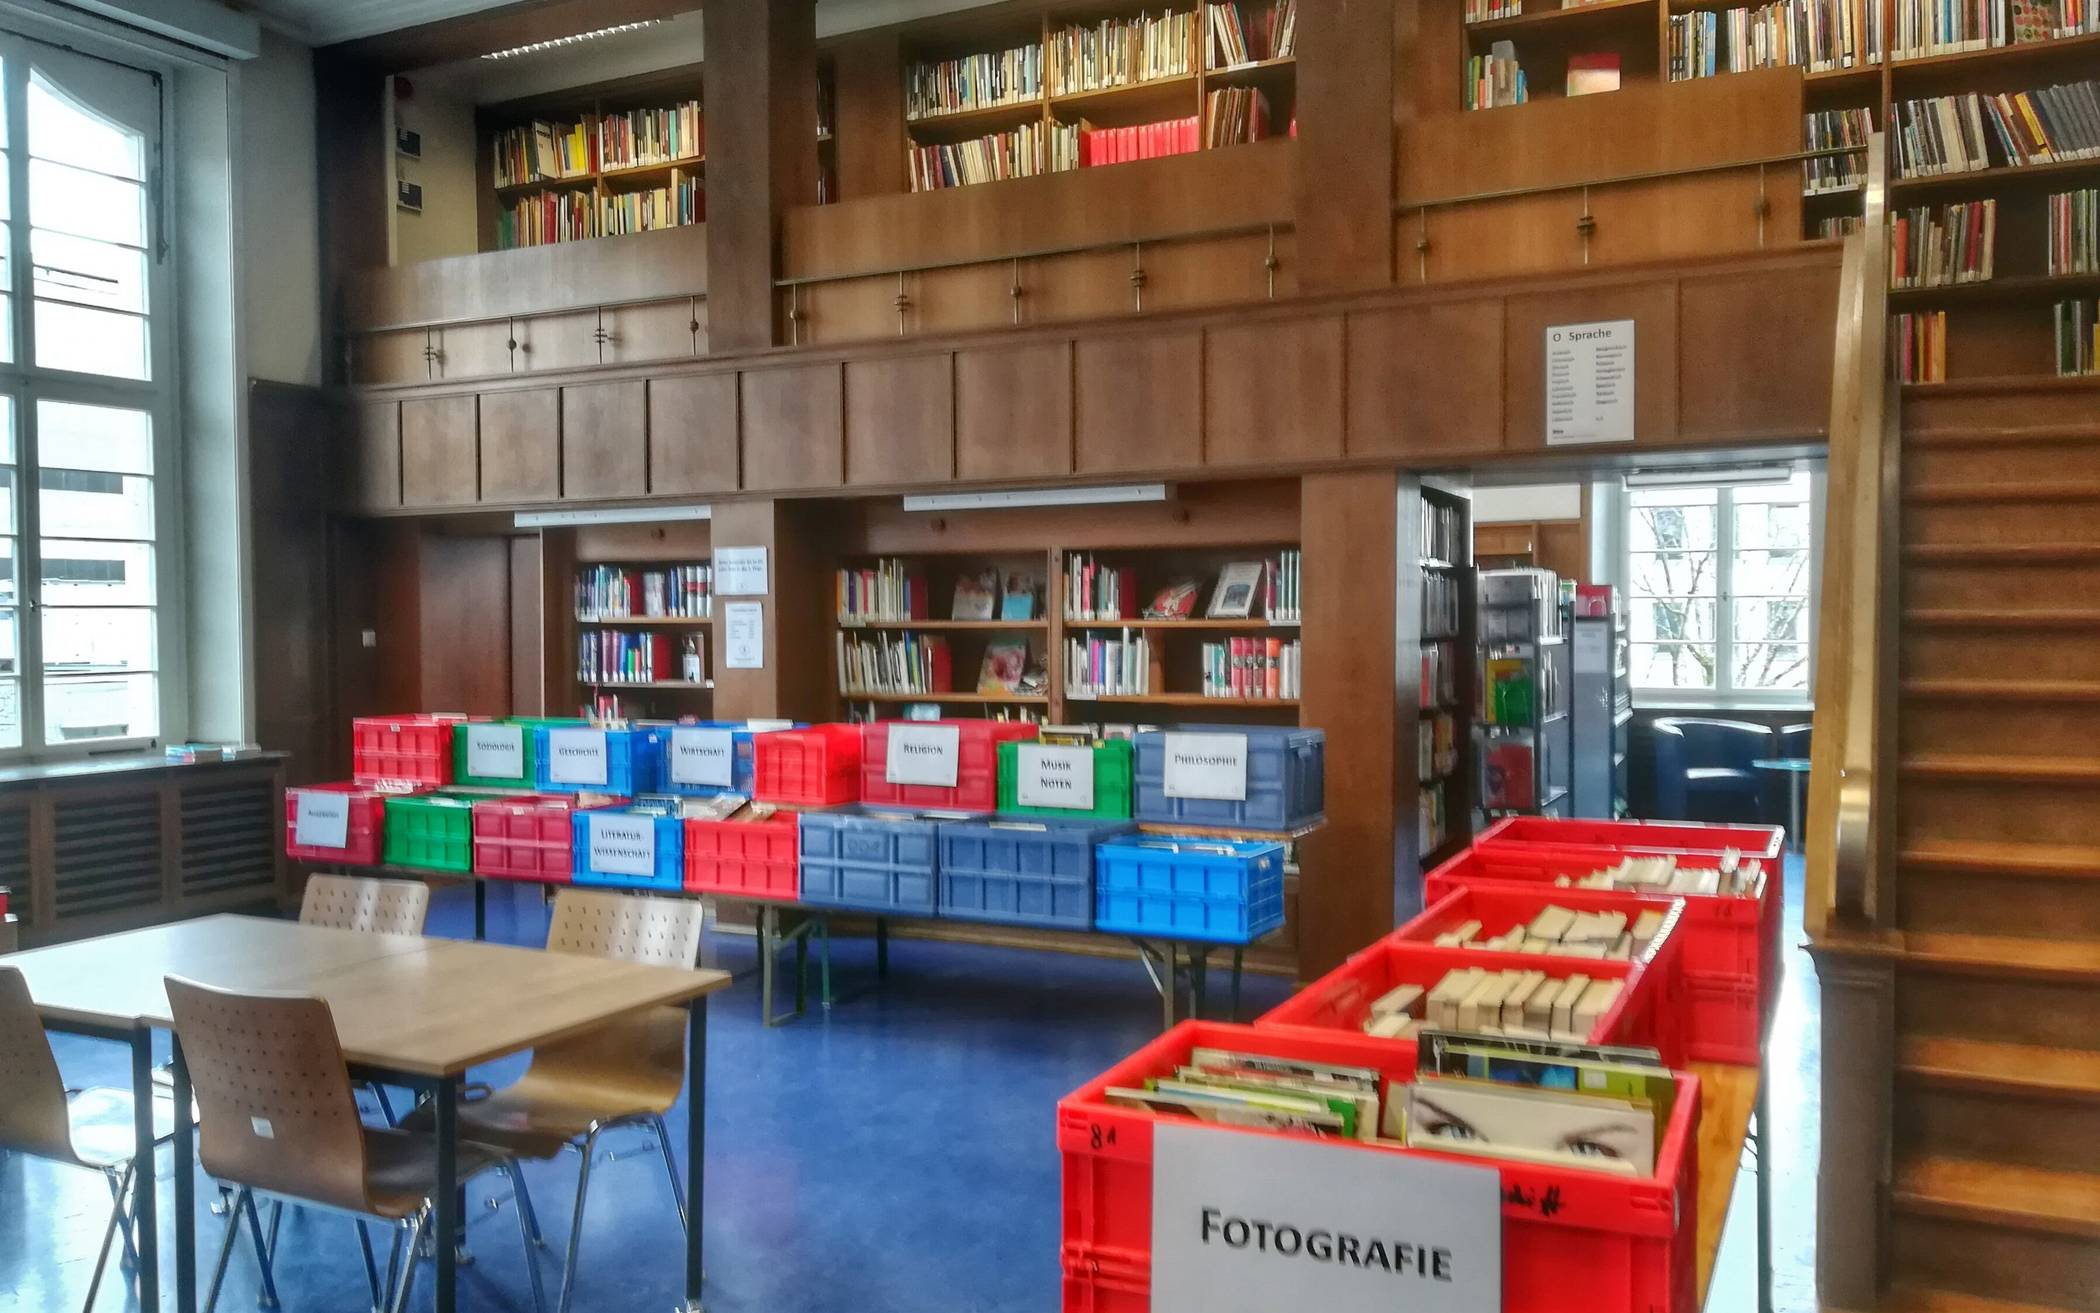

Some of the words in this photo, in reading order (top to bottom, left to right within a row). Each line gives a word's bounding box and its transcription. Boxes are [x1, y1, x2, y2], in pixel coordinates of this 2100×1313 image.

[1569, 328, 1612, 343] Sprache
[680, 745, 725, 757] WIRTSCHAFT
[903, 742, 943, 755] RELIGION
[1041, 757, 1071, 771] MUSIK
[1174, 754, 1238, 767] PHILOSOPHIE
[1040, 776, 1072, 790] NOTEN
[601, 828, 641, 841] LITERATUR
[593, 847, 650, 859] WISSENSCHAFT
[1201, 1206, 1452, 1283] FOTOGRAFIE
